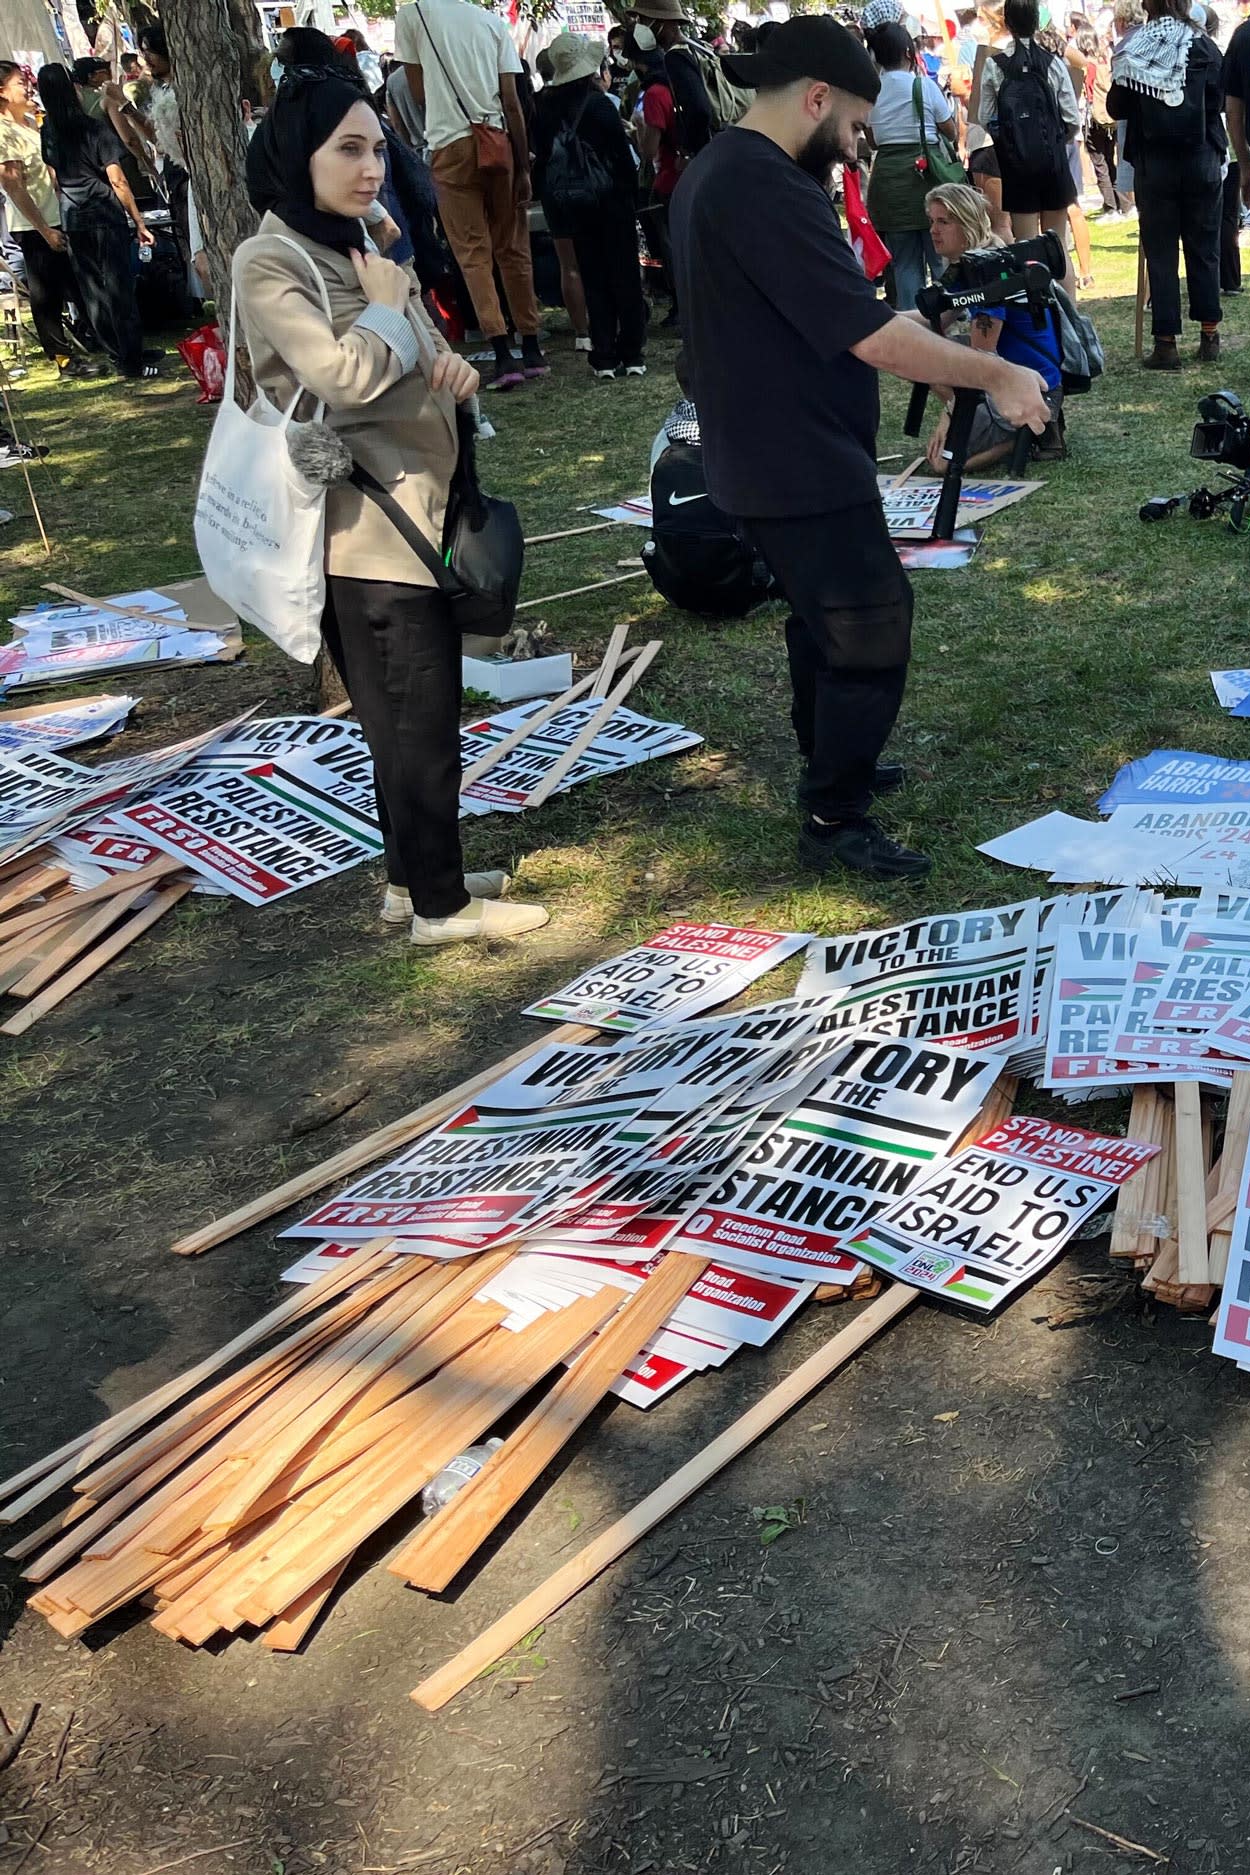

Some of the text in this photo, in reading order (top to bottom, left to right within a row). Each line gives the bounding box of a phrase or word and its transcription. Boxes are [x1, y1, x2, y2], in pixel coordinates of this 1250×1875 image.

[952, 292, 985, 307] RONIN
[325, 780, 357, 797] TO
[1137, 775, 1218, 795] HARRIS
[209, 776, 370, 865] PALESTINIAN
[165, 791, 331, 883] RESISTANCE
[648, 935, 763, 960] PALESTINE!
[667, 925, 776, 947] STAND WITH
[825, 908, 1025, 974] VICTORY
[623, 951, 731, 976] END U.S
[878, 946, 959, 973] TO THE
[591, 963, 706, 995] AID TO
[565, 979, 682, 1012] ISRAEL!
[828, 1078, 889, 1110] THE
[398, 1122, 621, 1166] PALESTINIAN
[984, 1131, 1135, 1180] PALESTINE!
[1002, 1117, 1153, 1162] STAND WITH
[346, 1158, 578, 1200] RESISTANCE
[951, 1153, 1098, 1209] END U.S
[318, 1205, 416, 1225] FRSO
[918, 1177, 1070, 1242] AID TO
[713, 1228, 842, 1266] Socialist Organization
[720, 1217, 807, 1247] Freedom Road
[885, 1201, 1045, 1271] ISRAEL!
[701, 1270, 735, 1289] Road
[692, 1282, 767, 1312] Organization
